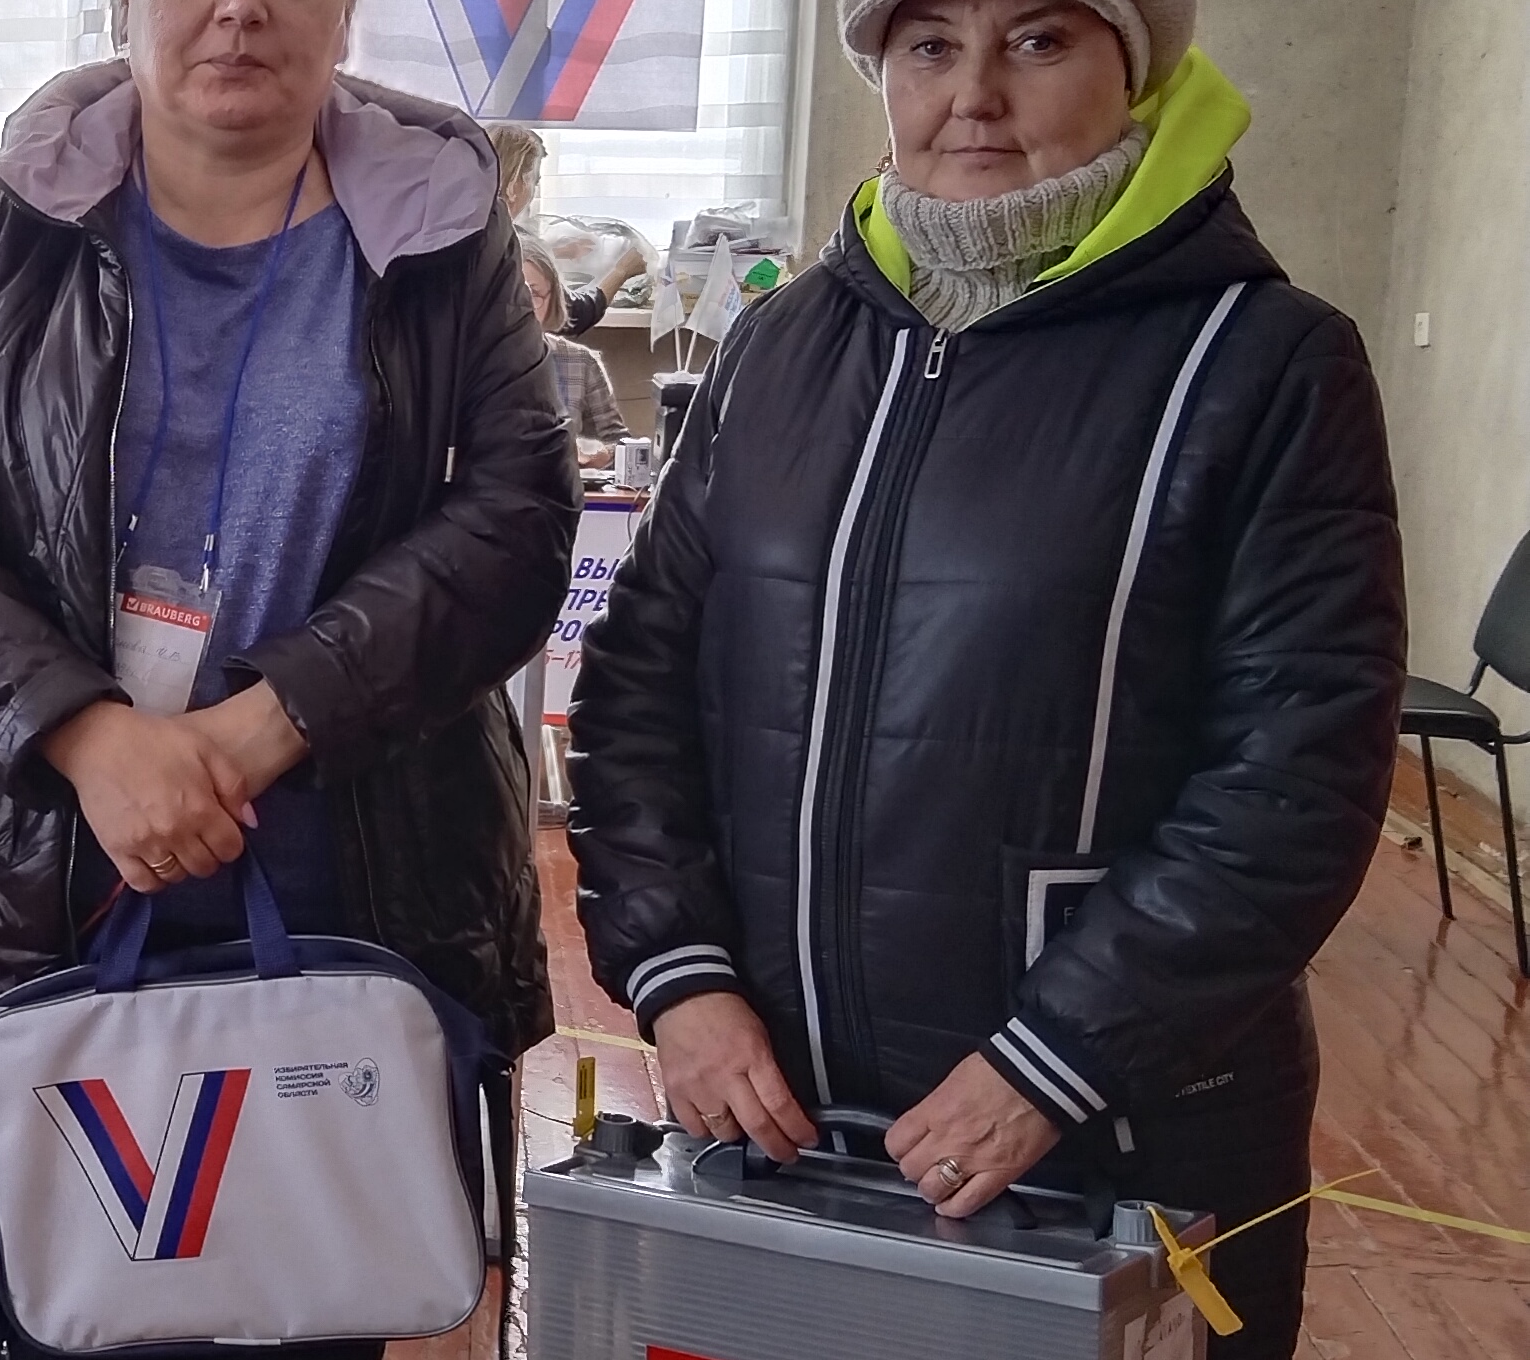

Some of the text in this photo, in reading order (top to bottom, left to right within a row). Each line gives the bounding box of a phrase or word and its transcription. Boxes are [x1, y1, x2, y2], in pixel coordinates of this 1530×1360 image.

[139, 602, 202, 627] BRAUBERG
[552, 619, 582, 642] РО
[273, 1062, 349, 1074] ИЗБИРАТЕЛЬНАЯ
[275, 1072, 324, 1082] КОМИССИЯ
[1216, 1071, 1234, 1086] CITY
[276, 1079, 331, 1090] САМАРСКОЙ
[277, 1089, 319, 1099] ОБЛАСТИ
